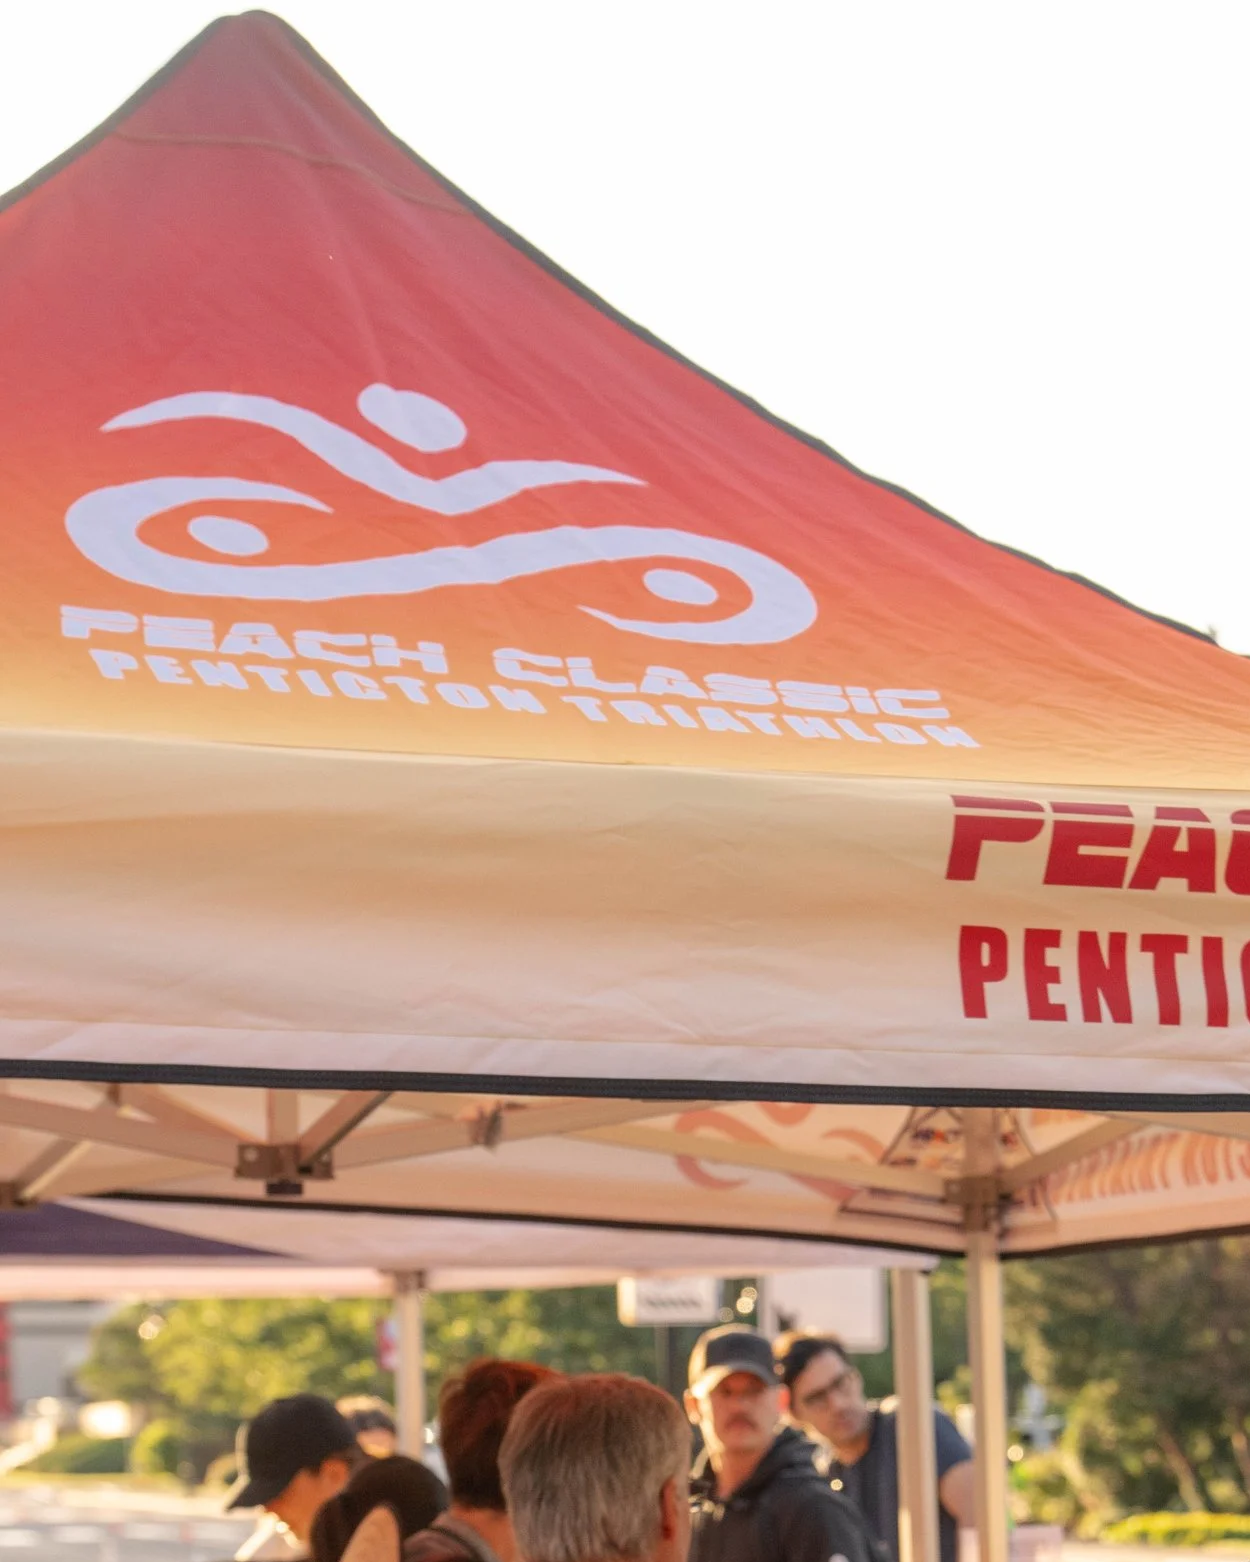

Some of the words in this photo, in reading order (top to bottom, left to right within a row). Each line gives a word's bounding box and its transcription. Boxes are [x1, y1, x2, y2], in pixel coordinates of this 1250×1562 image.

[61, 604, 445, 674] PEACH
[493, 648, 950, 720] CLASSIC
[89, 648, 546, 715] PENTICTON
[561, 694, 981, 749] TRIATHLON
